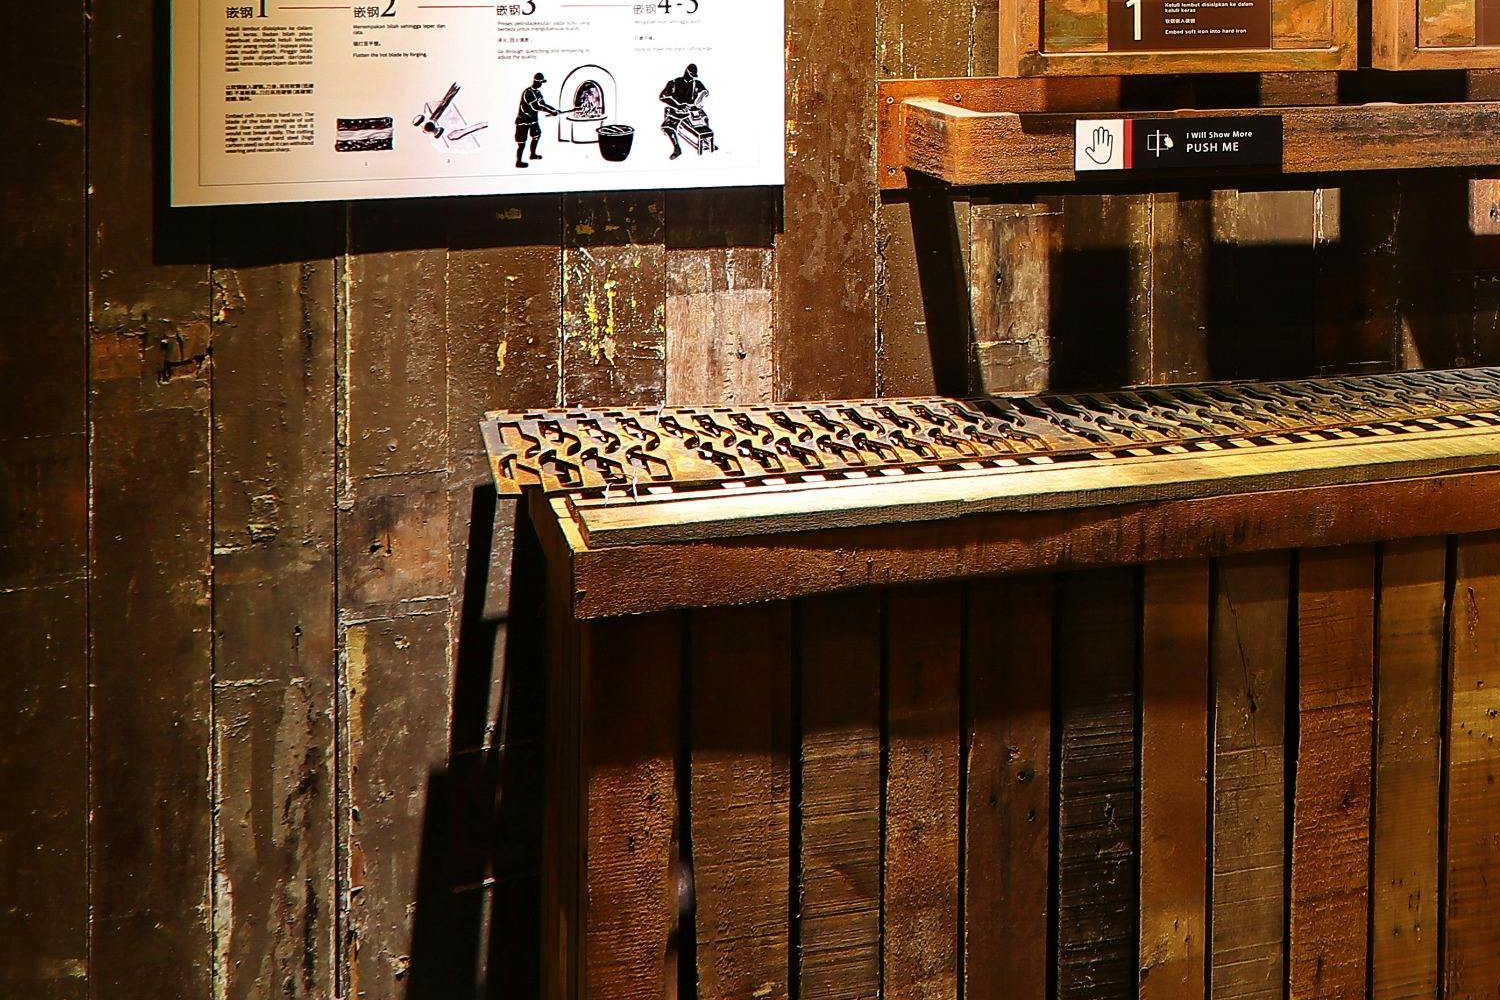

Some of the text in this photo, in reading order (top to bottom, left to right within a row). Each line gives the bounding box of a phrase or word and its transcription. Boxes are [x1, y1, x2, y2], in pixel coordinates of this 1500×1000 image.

[1191, 131, 1206, 139] Will
[1209, 130, 1230, 138] Show
[1232, 130, 1253, 138] More
[1186, 141, 1239, 153] PUSH ME
